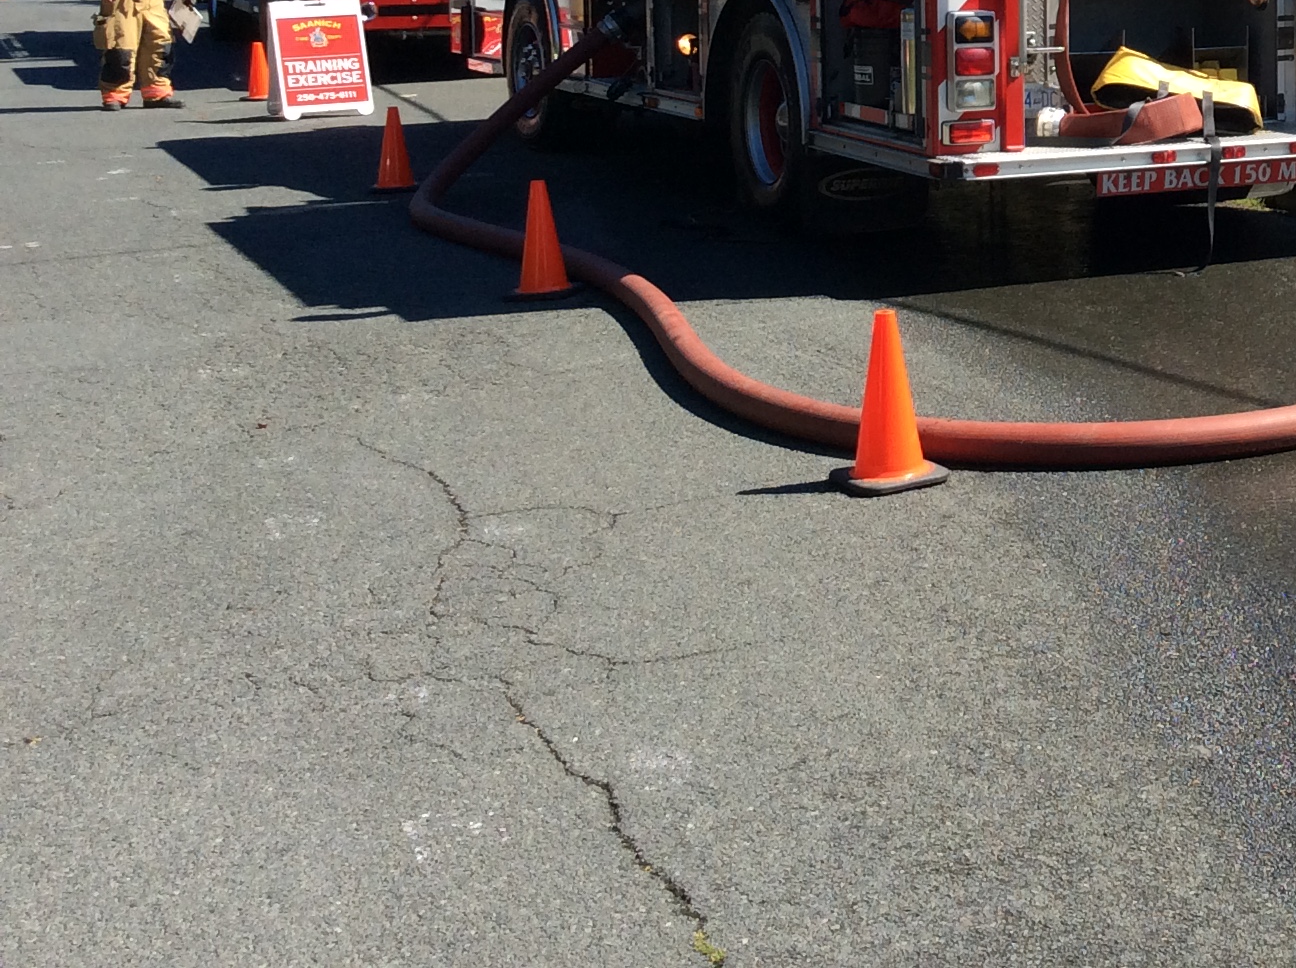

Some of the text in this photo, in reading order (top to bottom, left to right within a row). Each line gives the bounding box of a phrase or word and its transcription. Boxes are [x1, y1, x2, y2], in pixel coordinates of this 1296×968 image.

[292, 20, 341, 32] SAANICH
[284, 58, 359, 73] TRAINING
[287, 71, 362, 87] EXERCISE
[1102, 171, 1158, 194] KEEP
[1234, 162, 1271, 185] 150
